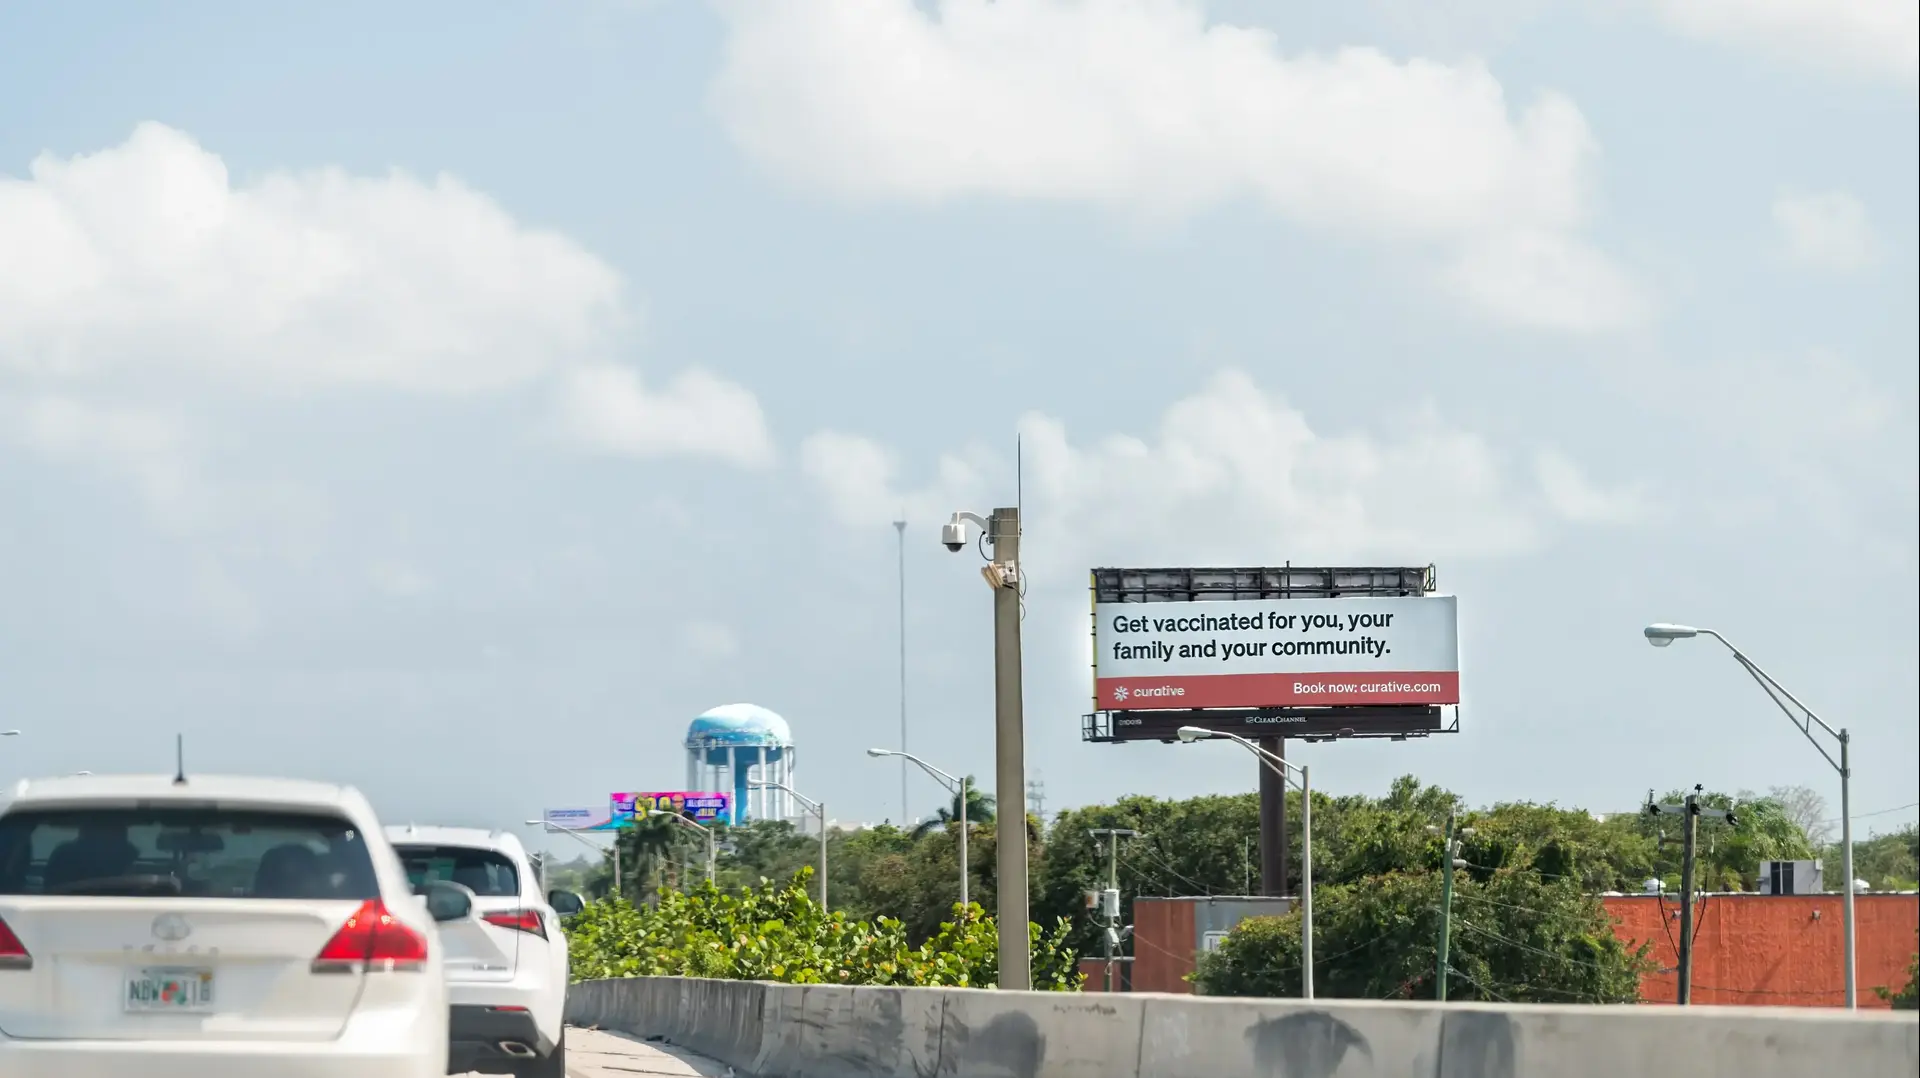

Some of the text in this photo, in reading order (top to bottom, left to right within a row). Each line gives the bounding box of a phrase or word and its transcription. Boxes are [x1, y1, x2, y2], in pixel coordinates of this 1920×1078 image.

[1113, 611, 1394, 633] Get vaccinated for you, your
[1113, 636, 1391, 662] family and your community.
[1133, 685, 1185, 697] curative
[1293, 680, 1441, 695] Book now: curative.com
